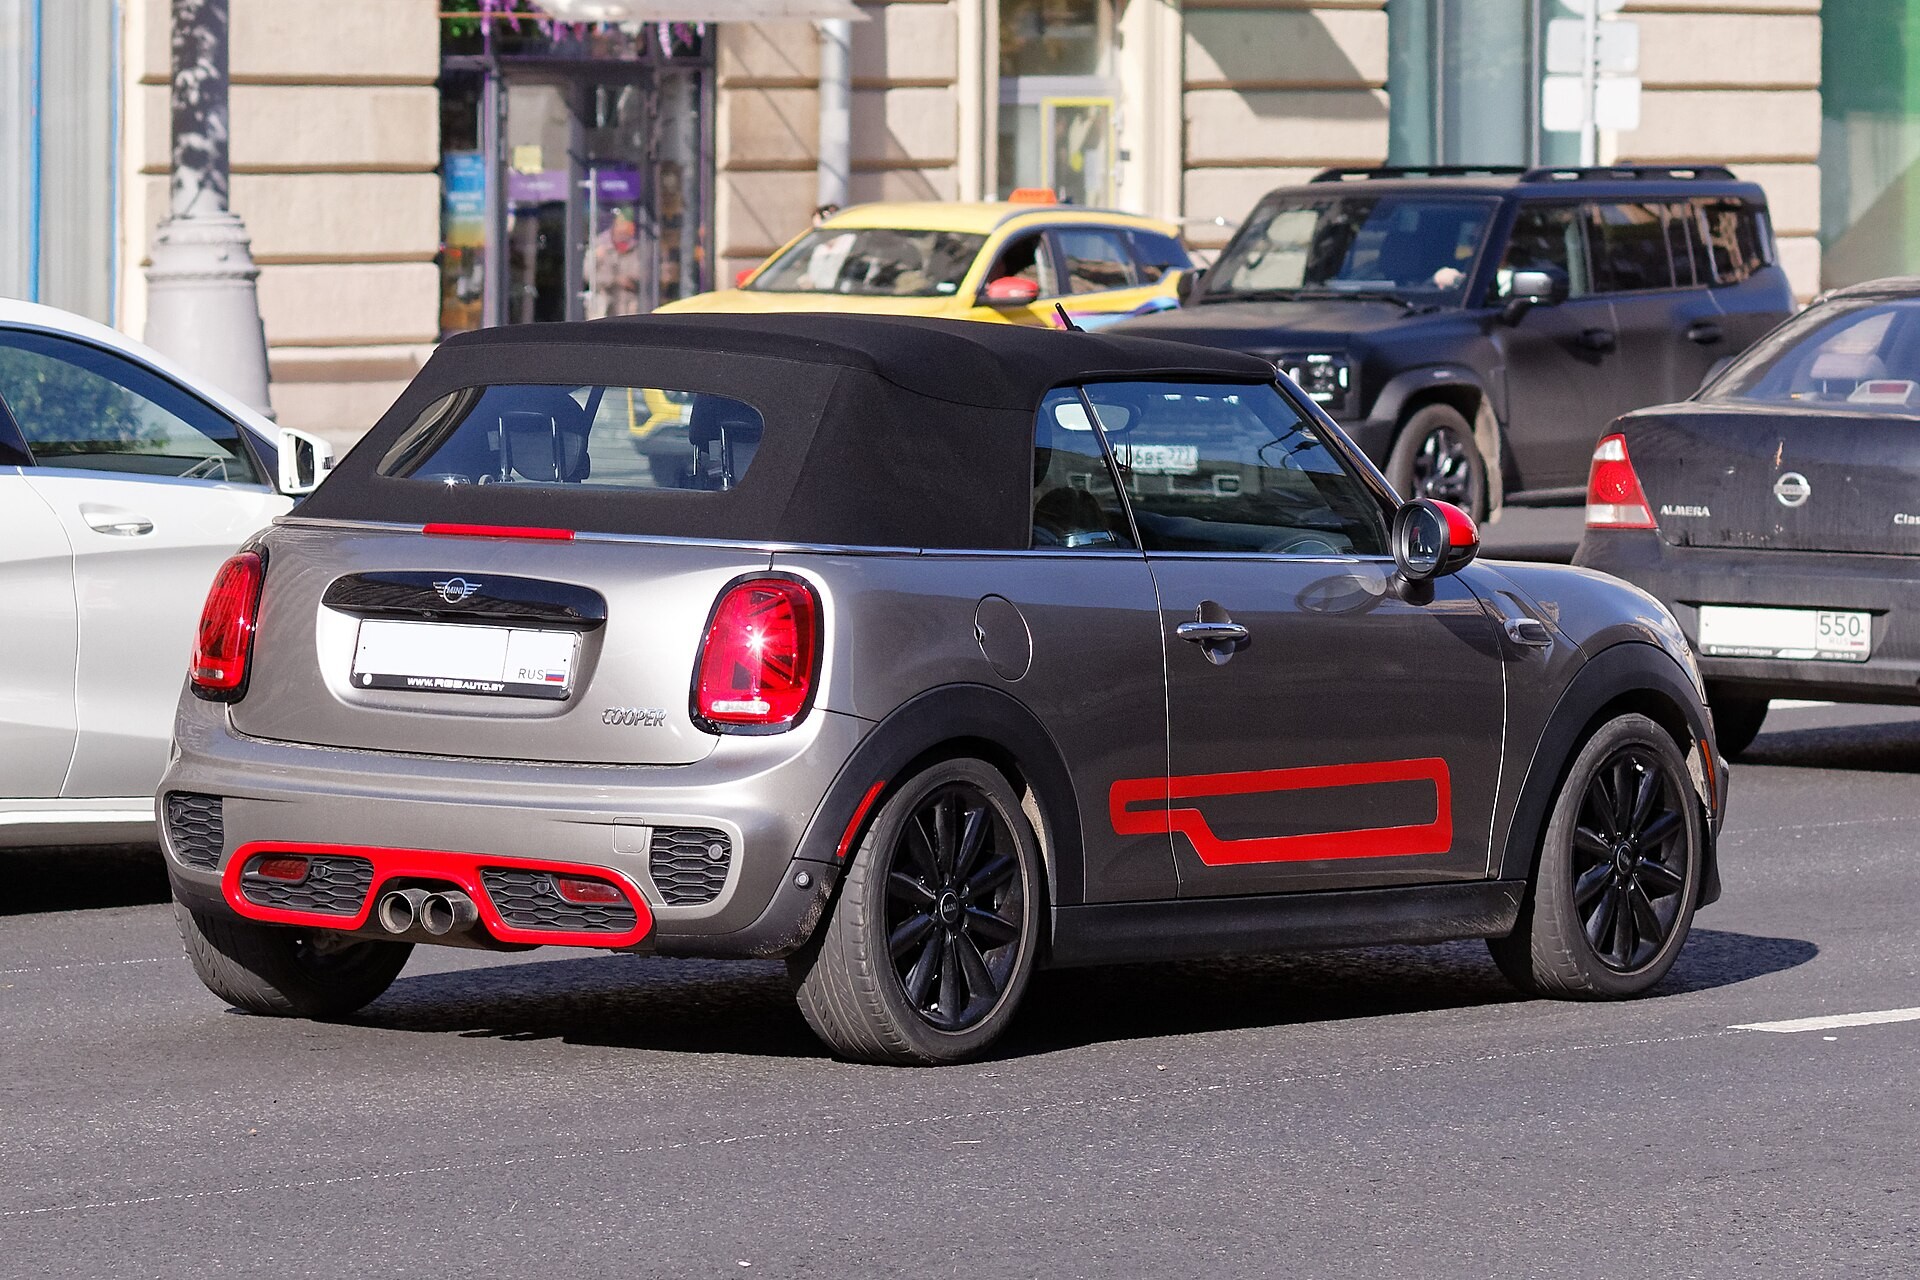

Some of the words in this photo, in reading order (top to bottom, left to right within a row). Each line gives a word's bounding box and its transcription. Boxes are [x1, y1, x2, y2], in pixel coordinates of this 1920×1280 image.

[1660, 504, 1711, 517] ALMERA
[446, 586, 464, 594] MINI
[1819, 615, 1860, 637] 550
[1828, 637, 1849, 646] RUS
[517, 668, 544, 681] RUS
[601, 706, 667, 727] COOPER
